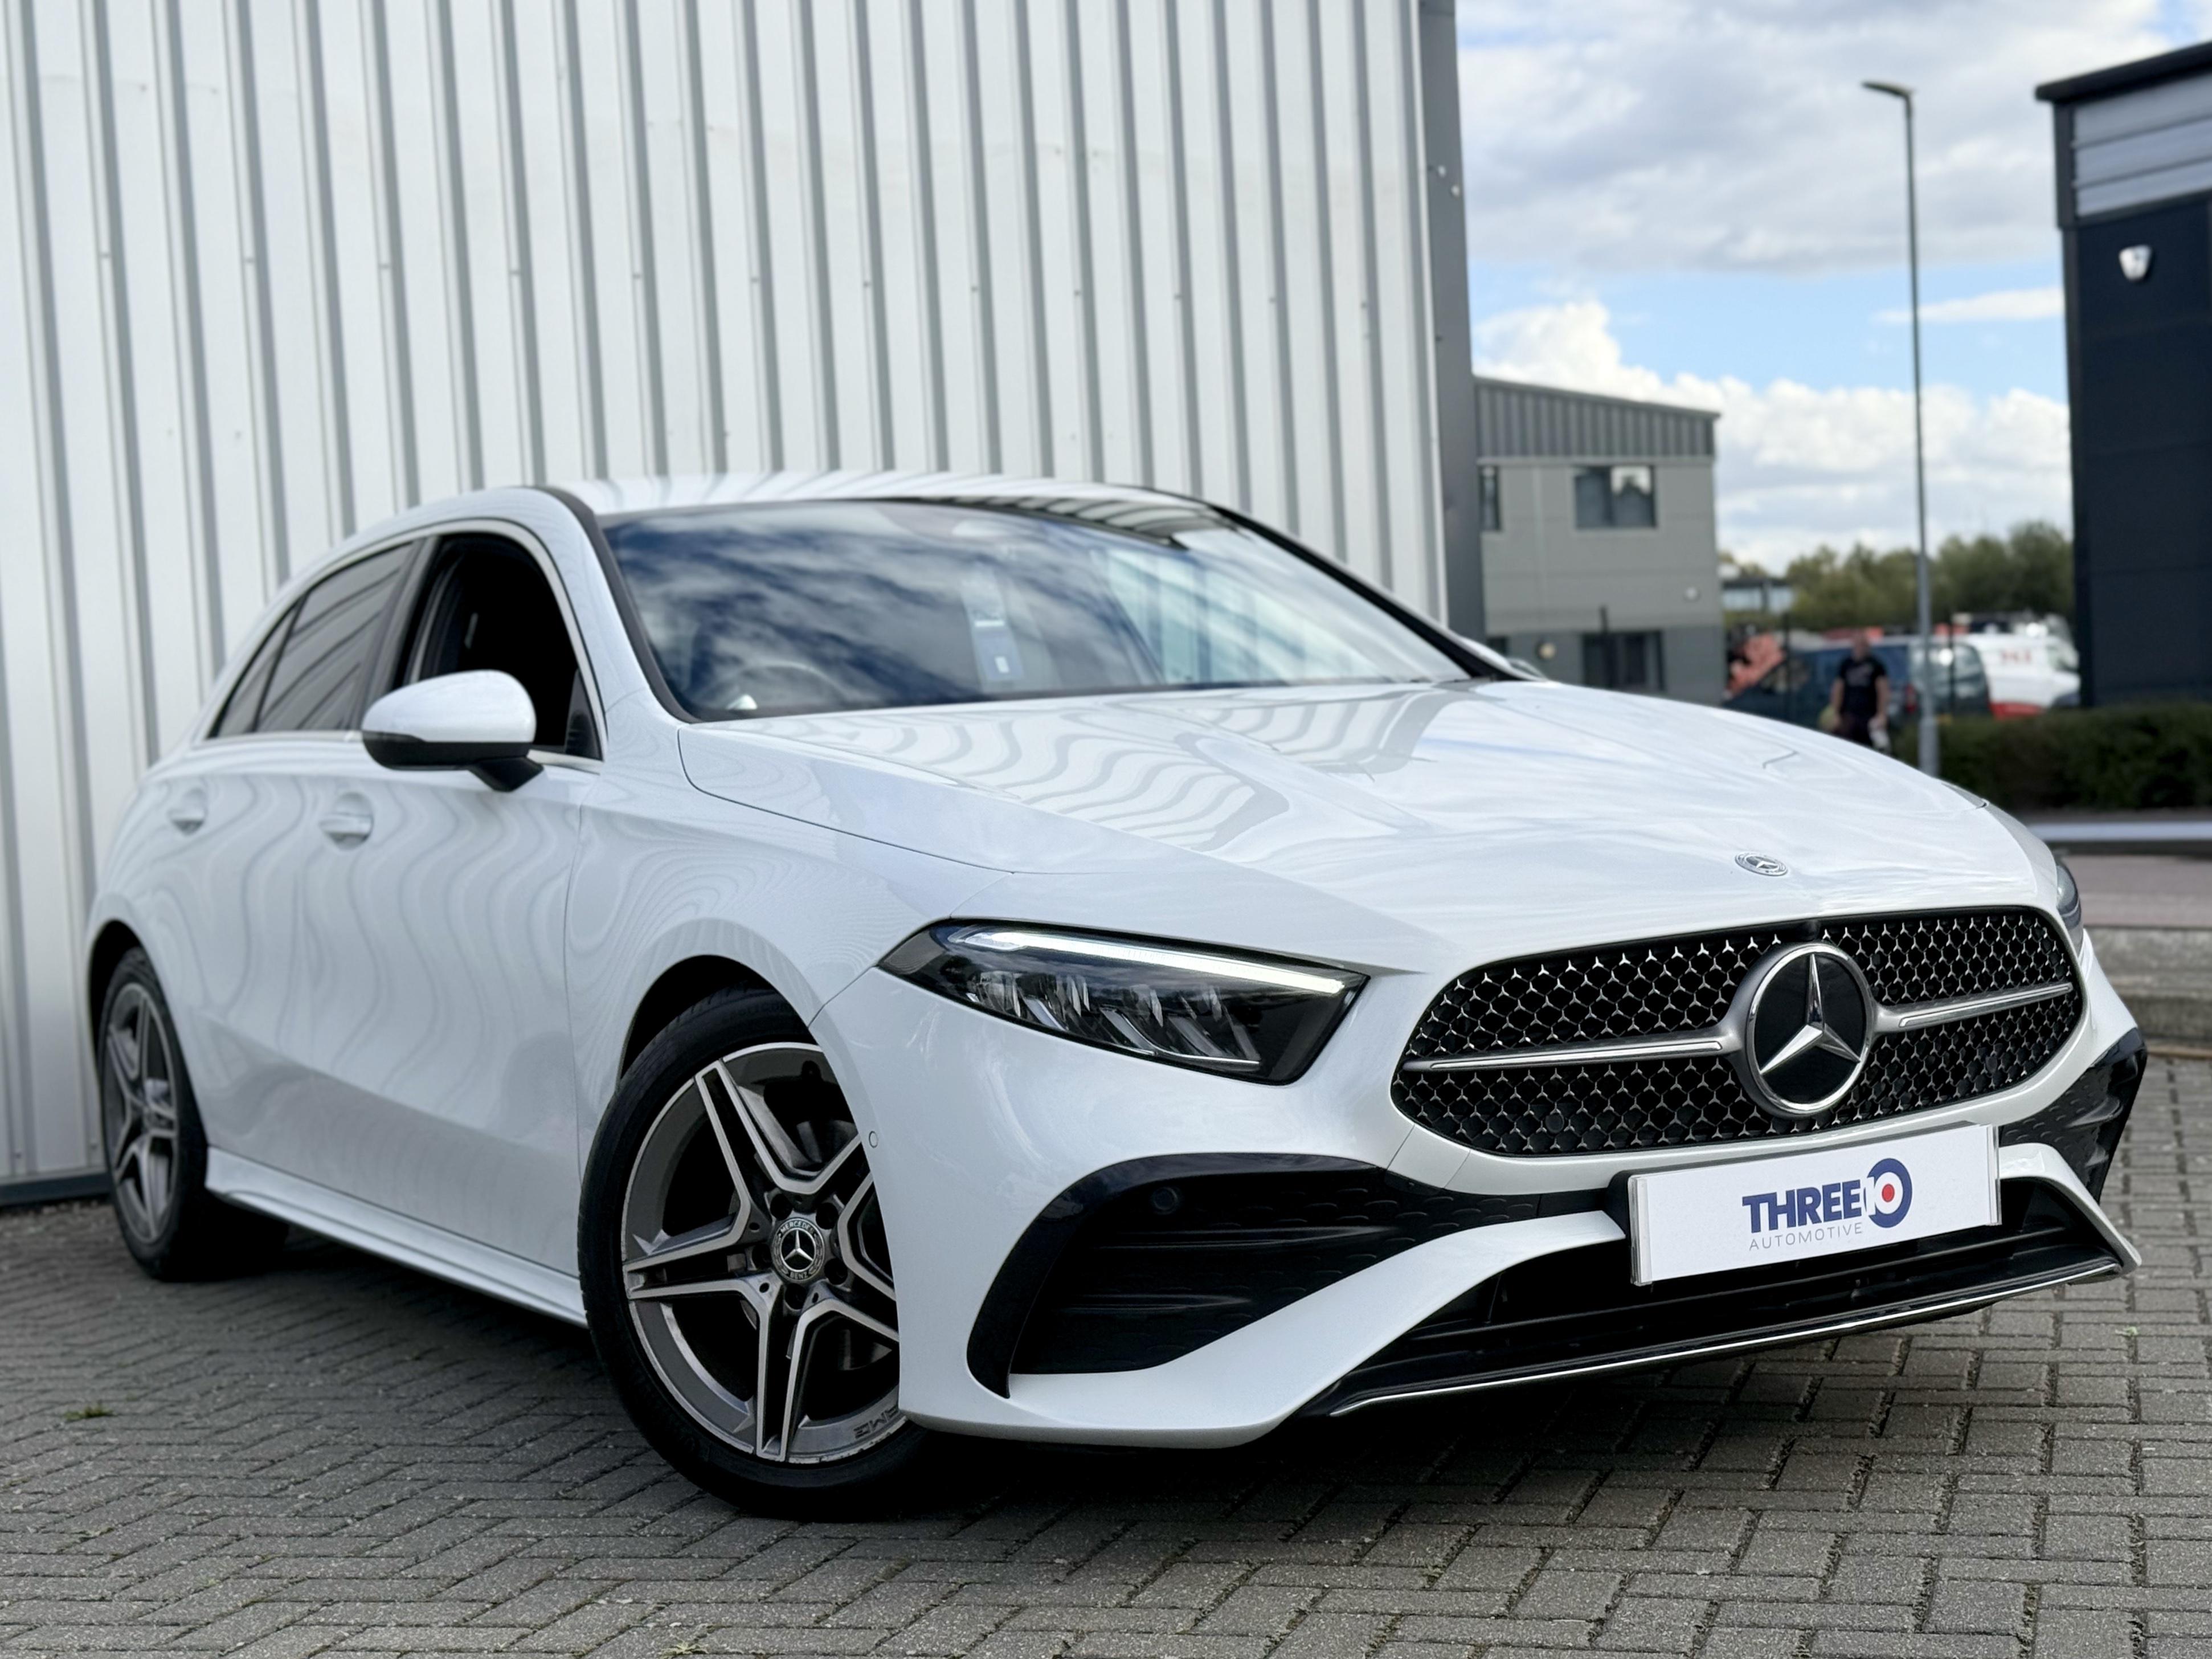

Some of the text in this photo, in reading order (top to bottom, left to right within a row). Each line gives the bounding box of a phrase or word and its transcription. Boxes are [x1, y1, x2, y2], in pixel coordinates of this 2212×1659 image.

[780, 1220, 815, 1235] MERCEDES
[1749, 1222, 1863, 1251] AUTOMOTIVE
[790, 1271, 809, 1280] BENZ
